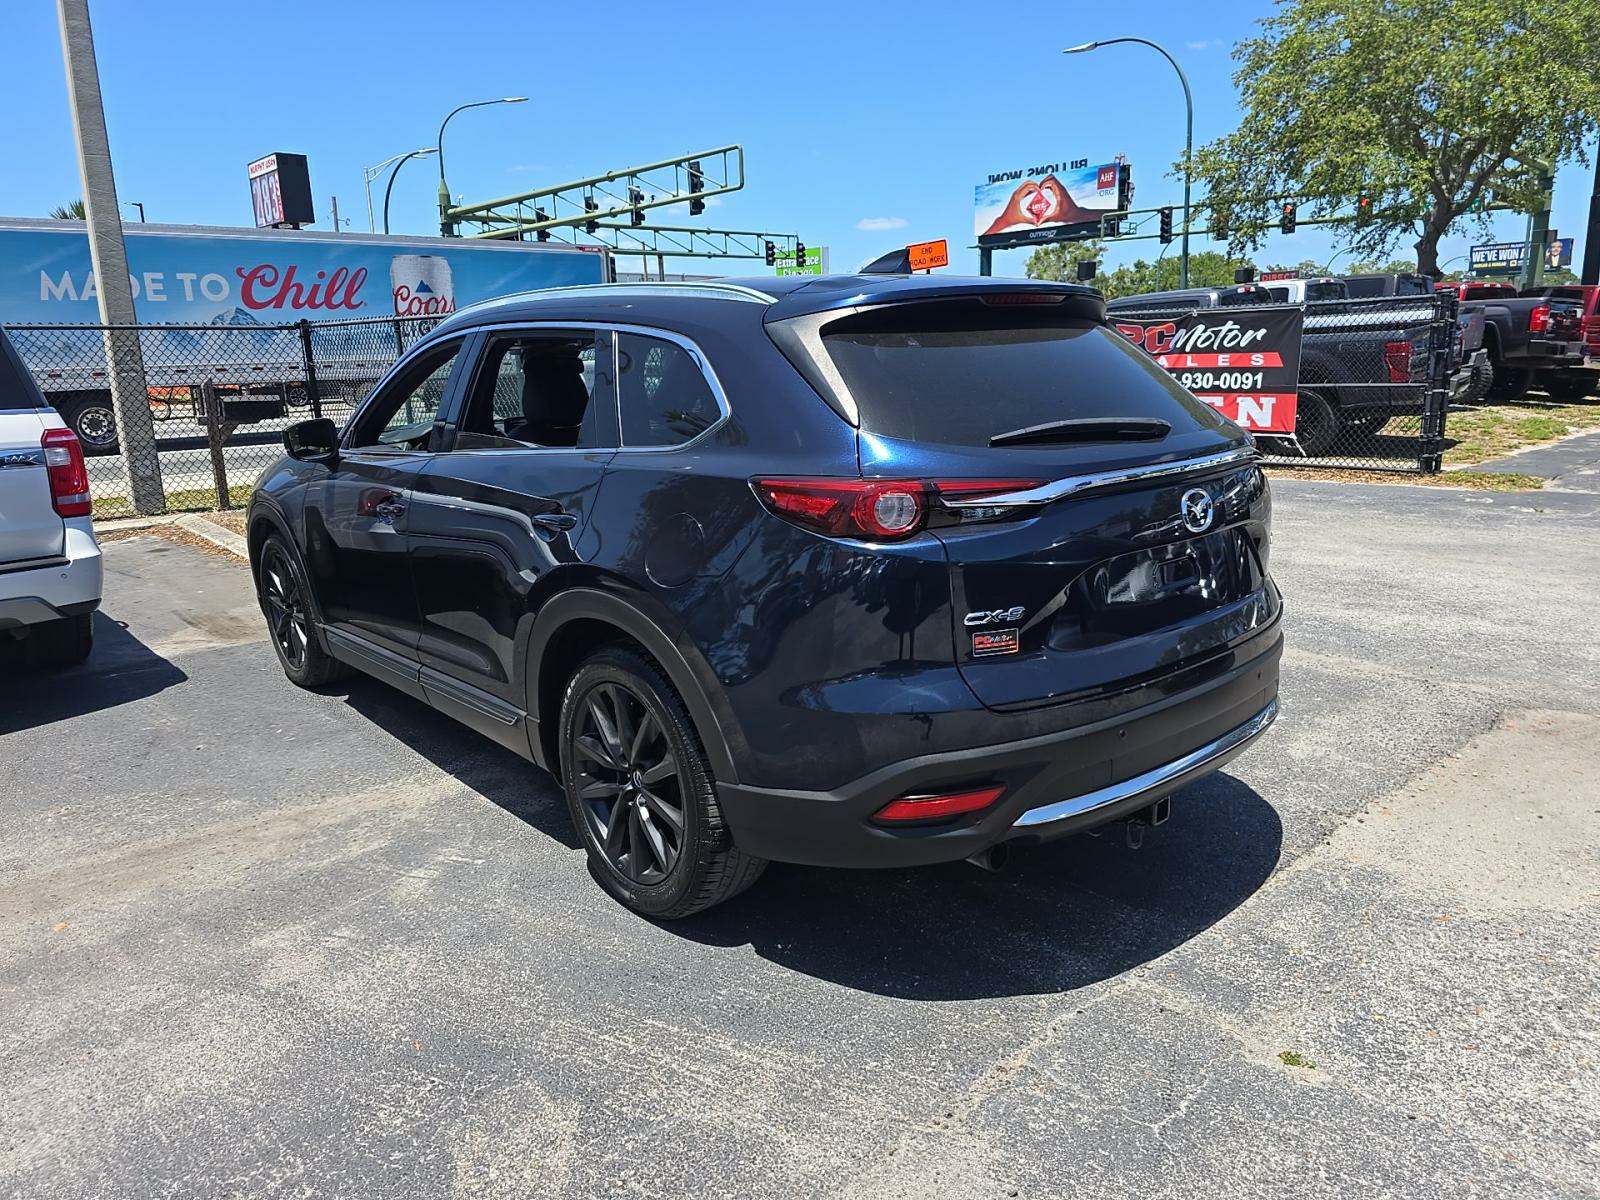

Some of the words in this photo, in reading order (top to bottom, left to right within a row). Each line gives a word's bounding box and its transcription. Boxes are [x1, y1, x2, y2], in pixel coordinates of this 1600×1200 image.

[1099, 171, 1114, 183] AHF
[921, 246, 933, 255] END
[1472, 249, 1498, 262] WE'VE
[1498, 248, 1519, 260] WON
[930, 255, 945, 263] WORK
[1262, 272, 1296, 281] DIRECT
[176, 273, 230, 302] TO
[235, 264, 368, 310] Chill
[392, 285, 456, 316] Coors
[1115, 322, 1176, 354] PC
[1169, 320, 1268, 352] Motor
[1157, 354, 1265, 368] ALES
[1171, 372, 1264, 390] -930-0091
[964, 606, 1026, 626] CX-9
